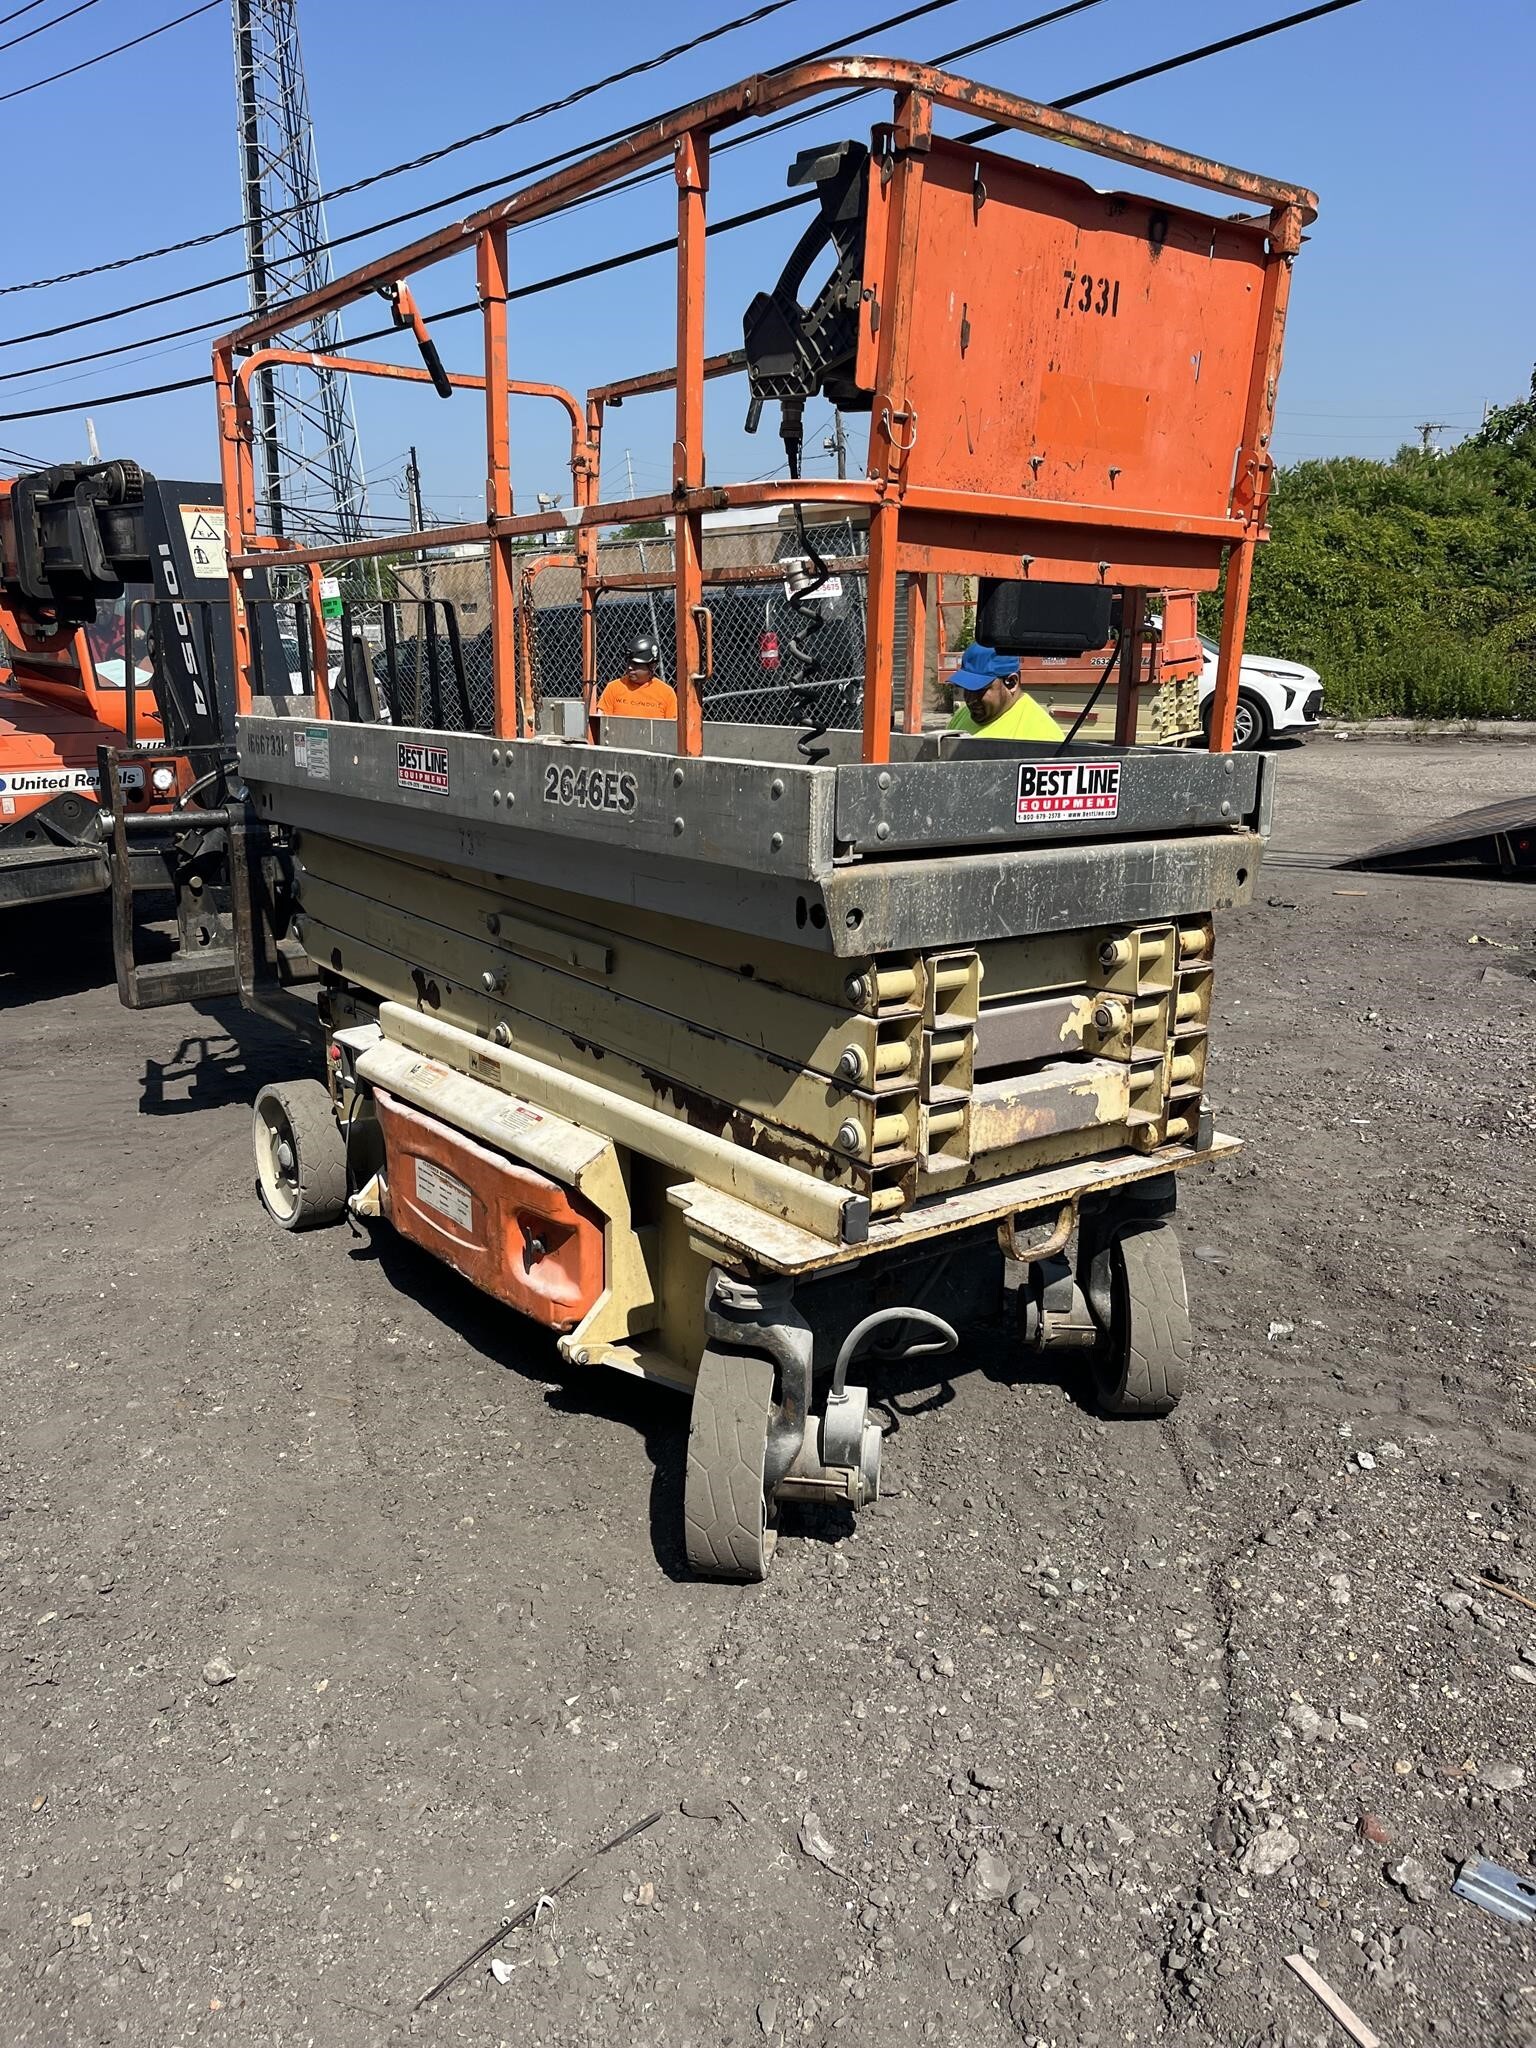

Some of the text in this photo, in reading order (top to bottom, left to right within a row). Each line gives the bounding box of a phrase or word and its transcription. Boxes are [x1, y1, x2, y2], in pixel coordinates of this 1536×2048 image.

[1063, 270, 1120, 318] 7331
[399, 744, 448, 774] BEST LINE
[11, 771, 136, 791] United Rels
[399, 770, 447, 785] EQUIPMENT
[544, 763, 639, 815] 2646ES
[1020, 766, 1119, 797] BEST LINE
[1020, 797, 1116, 811] EQUIPMENT
